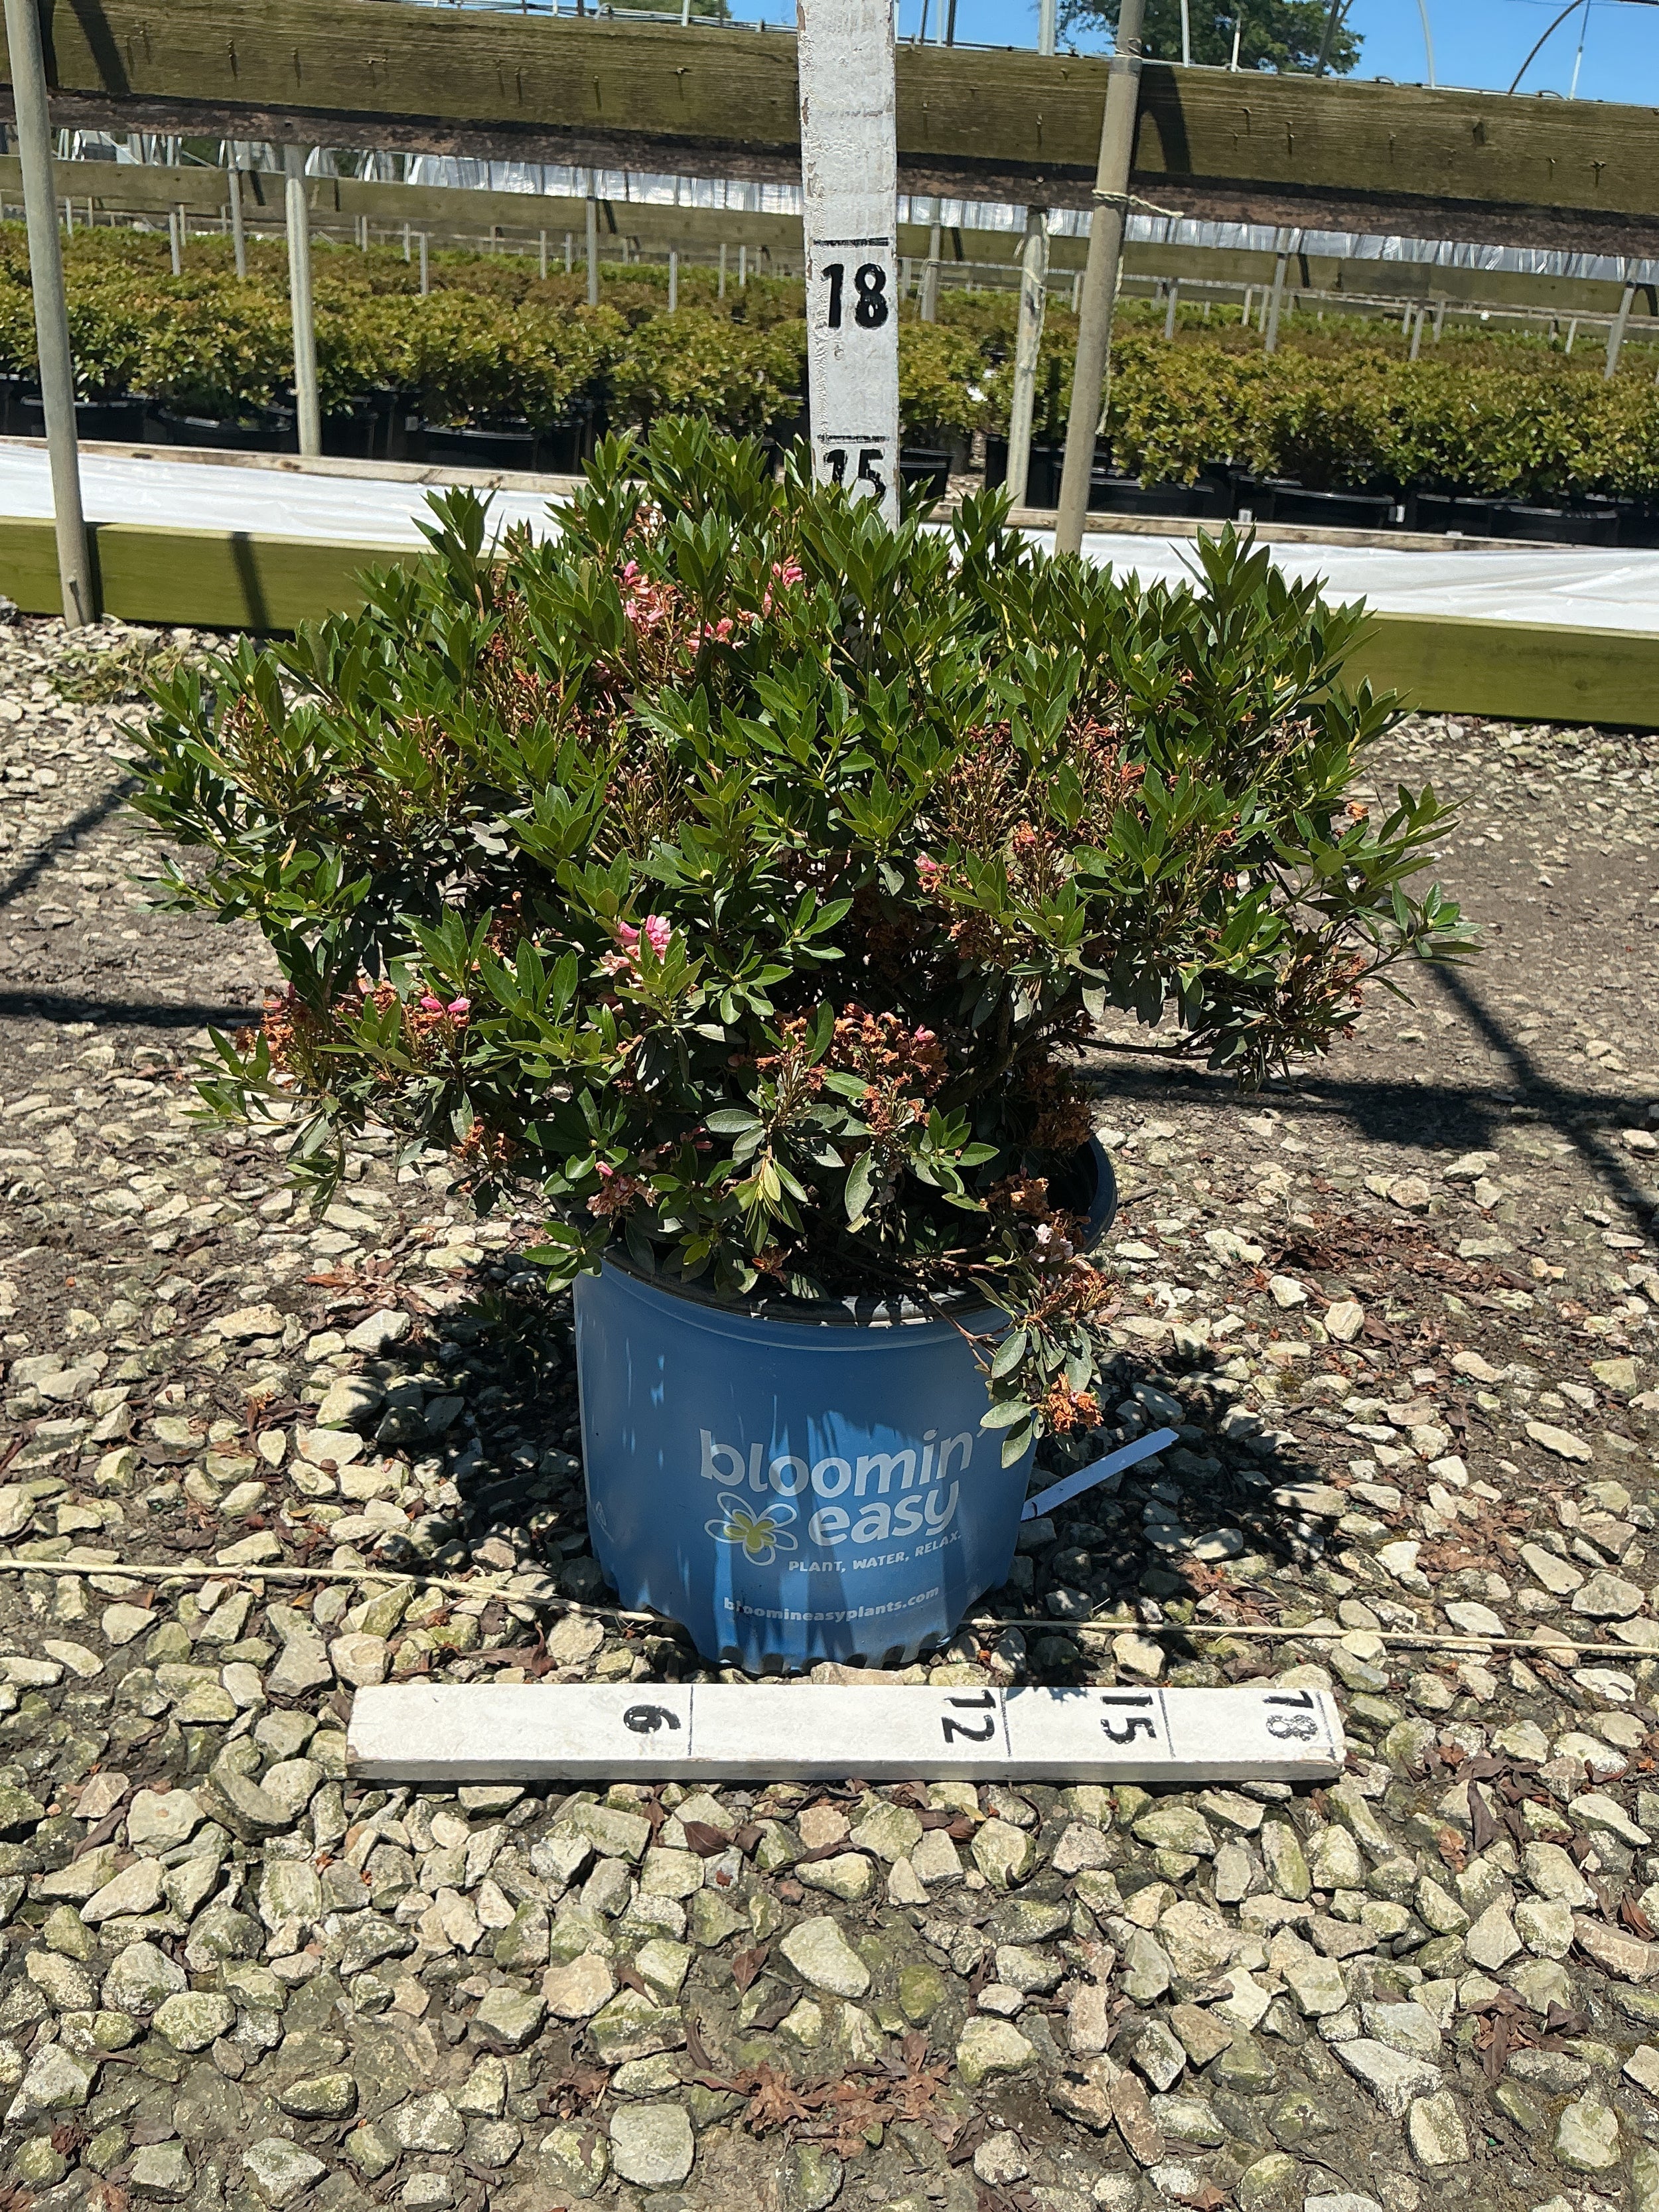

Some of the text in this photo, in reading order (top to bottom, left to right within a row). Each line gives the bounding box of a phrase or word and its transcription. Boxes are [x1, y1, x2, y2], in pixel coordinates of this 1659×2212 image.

[822, 263, 888, 329] 18
[808, 1480, 959, 1546] easy
[788, 1530, 962, 1573] PLANT, WATER, RELAX.
[723, 1587, 940, 1623] bloomineasyplants.com
[623, 1704, 682, 1734] 6
[941, 1689, 995, 1743] 12
[1100, 1693, 1157, 1745] 15
[1262, 1690, 1318, 1741] 18
